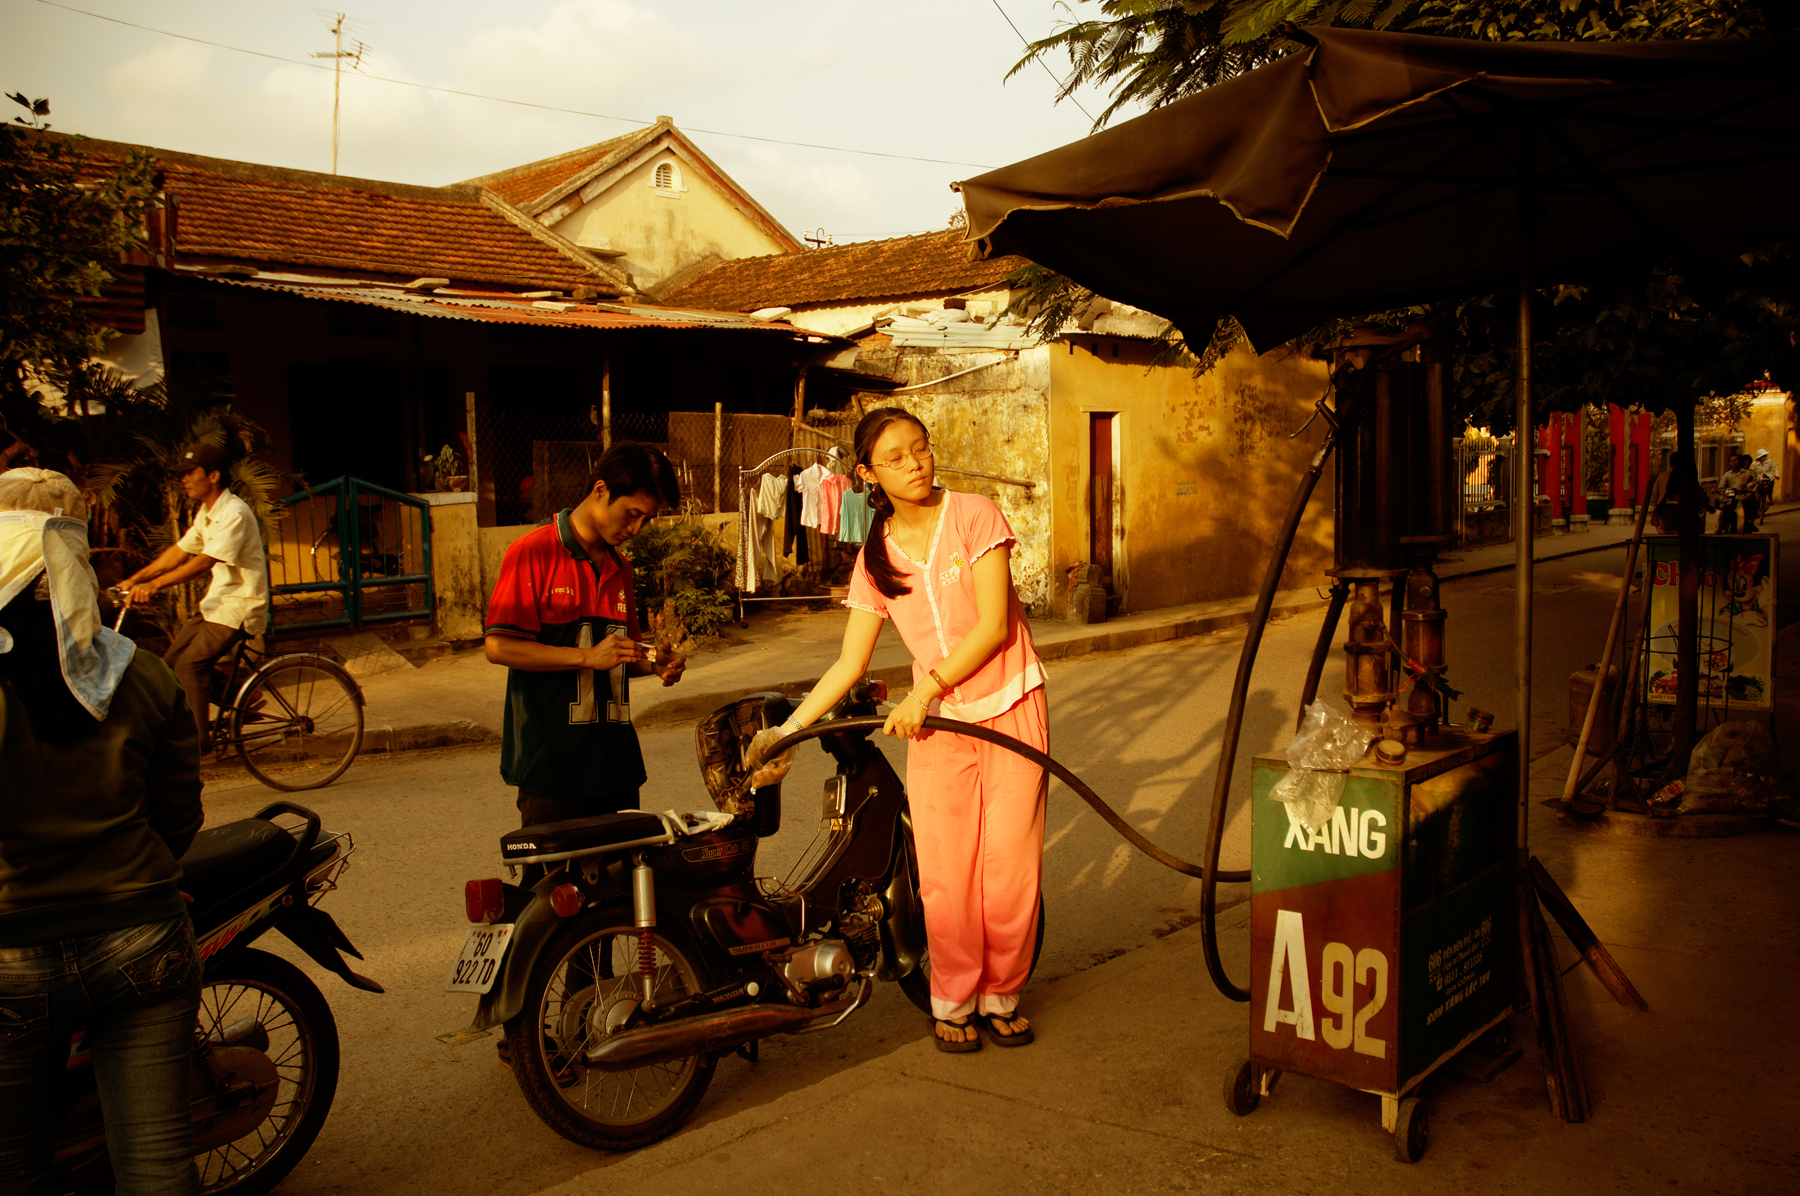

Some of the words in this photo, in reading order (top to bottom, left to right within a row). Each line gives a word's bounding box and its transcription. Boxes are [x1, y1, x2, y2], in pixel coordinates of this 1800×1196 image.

[1653, 560, 1720, 588] Cho
[568, 621, 631, 726] 11
[506, 842, 537, 851] HONDA
[700, 847, 723, 860] Super
[724, 843, 740, 855] Cub
[473, 932, 493, 957] 60
[732, 944, 761, 954] SUPER
[760, 940, 777, 950] CUB
[452, 959, 478, 985] 922
[476, 958, 496, 985] TD
[1428, 948, 1442, 973] 606
[716, 987, 744, 1002] HONDA
[1263, 908, 1316, 1042] A
[1321, 942, 1389, 1060] 92
